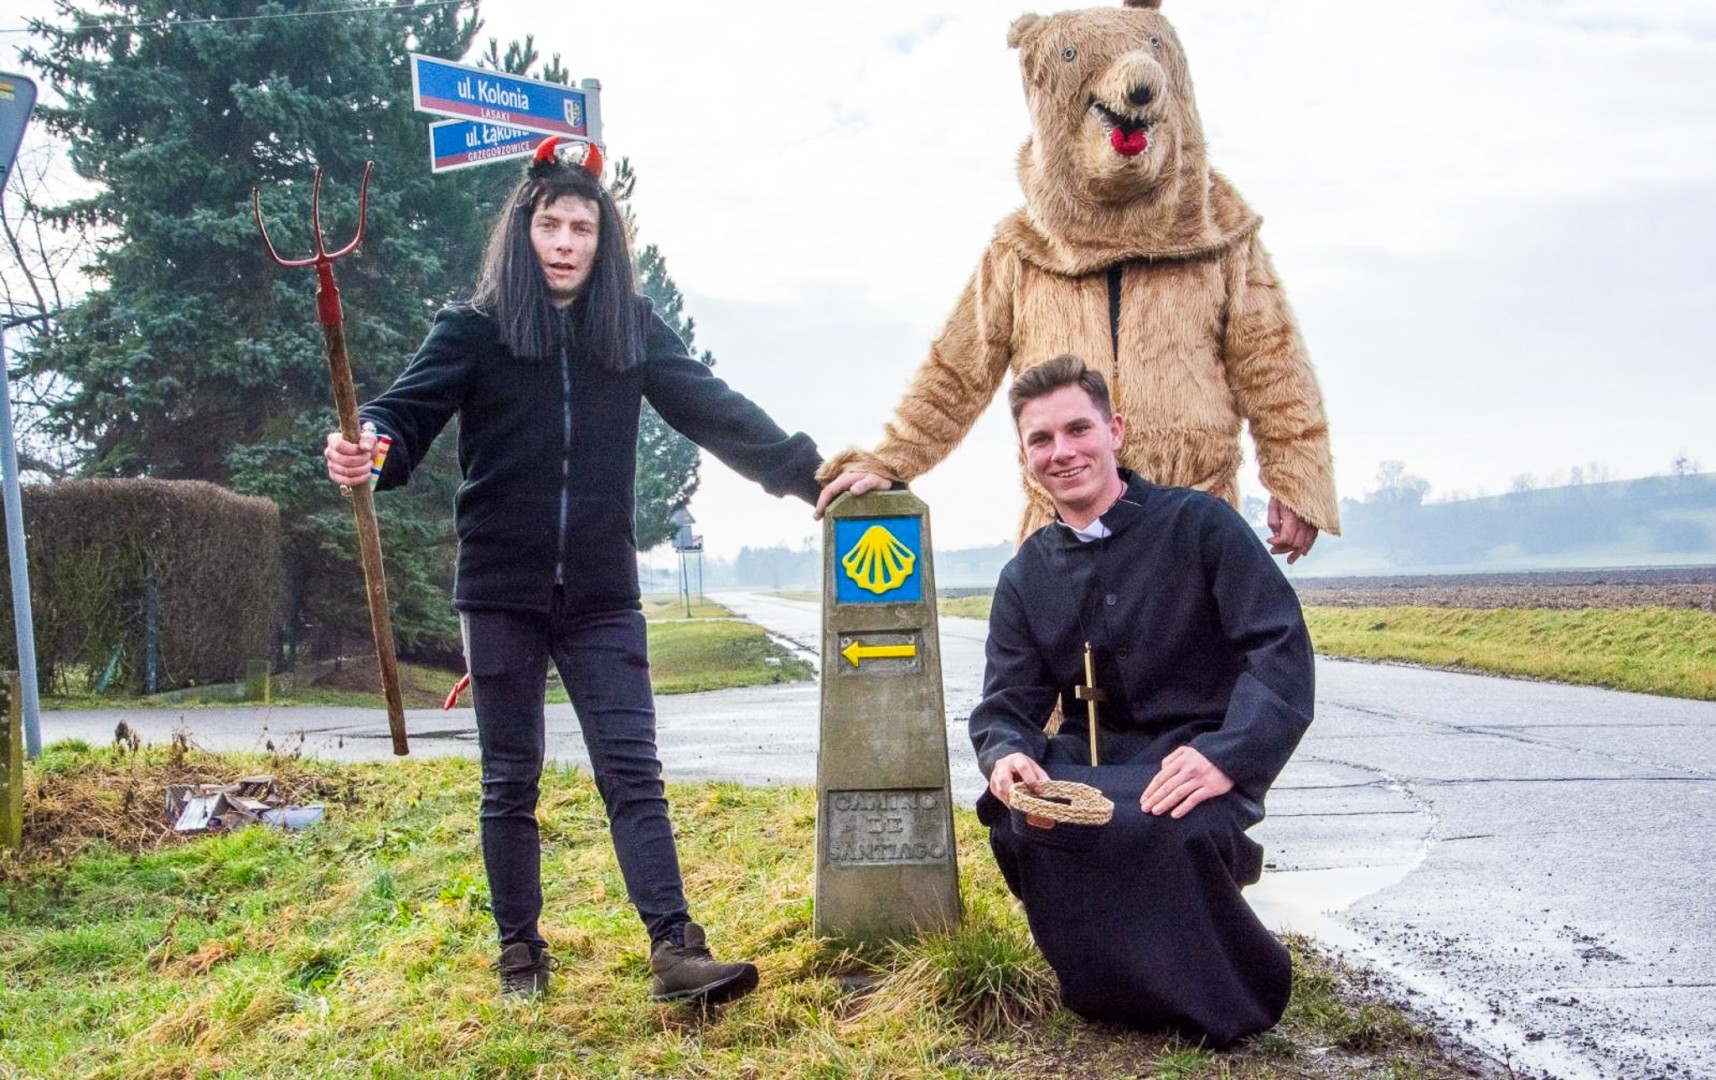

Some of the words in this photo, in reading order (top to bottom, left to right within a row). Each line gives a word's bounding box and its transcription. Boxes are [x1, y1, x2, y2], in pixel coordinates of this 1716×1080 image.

[457, 77, 475, 100] ul.
[478, 79, 529, 110] Kolonia
[466, 125, 481, 147] ul.
[468, 141, 530, 161] GRZEGORZOWICE
[834, 790, 939, 811] CAMINO
[867, 817, 903, 834] DE
[829, 840, 946, 861] SANTIAGO
